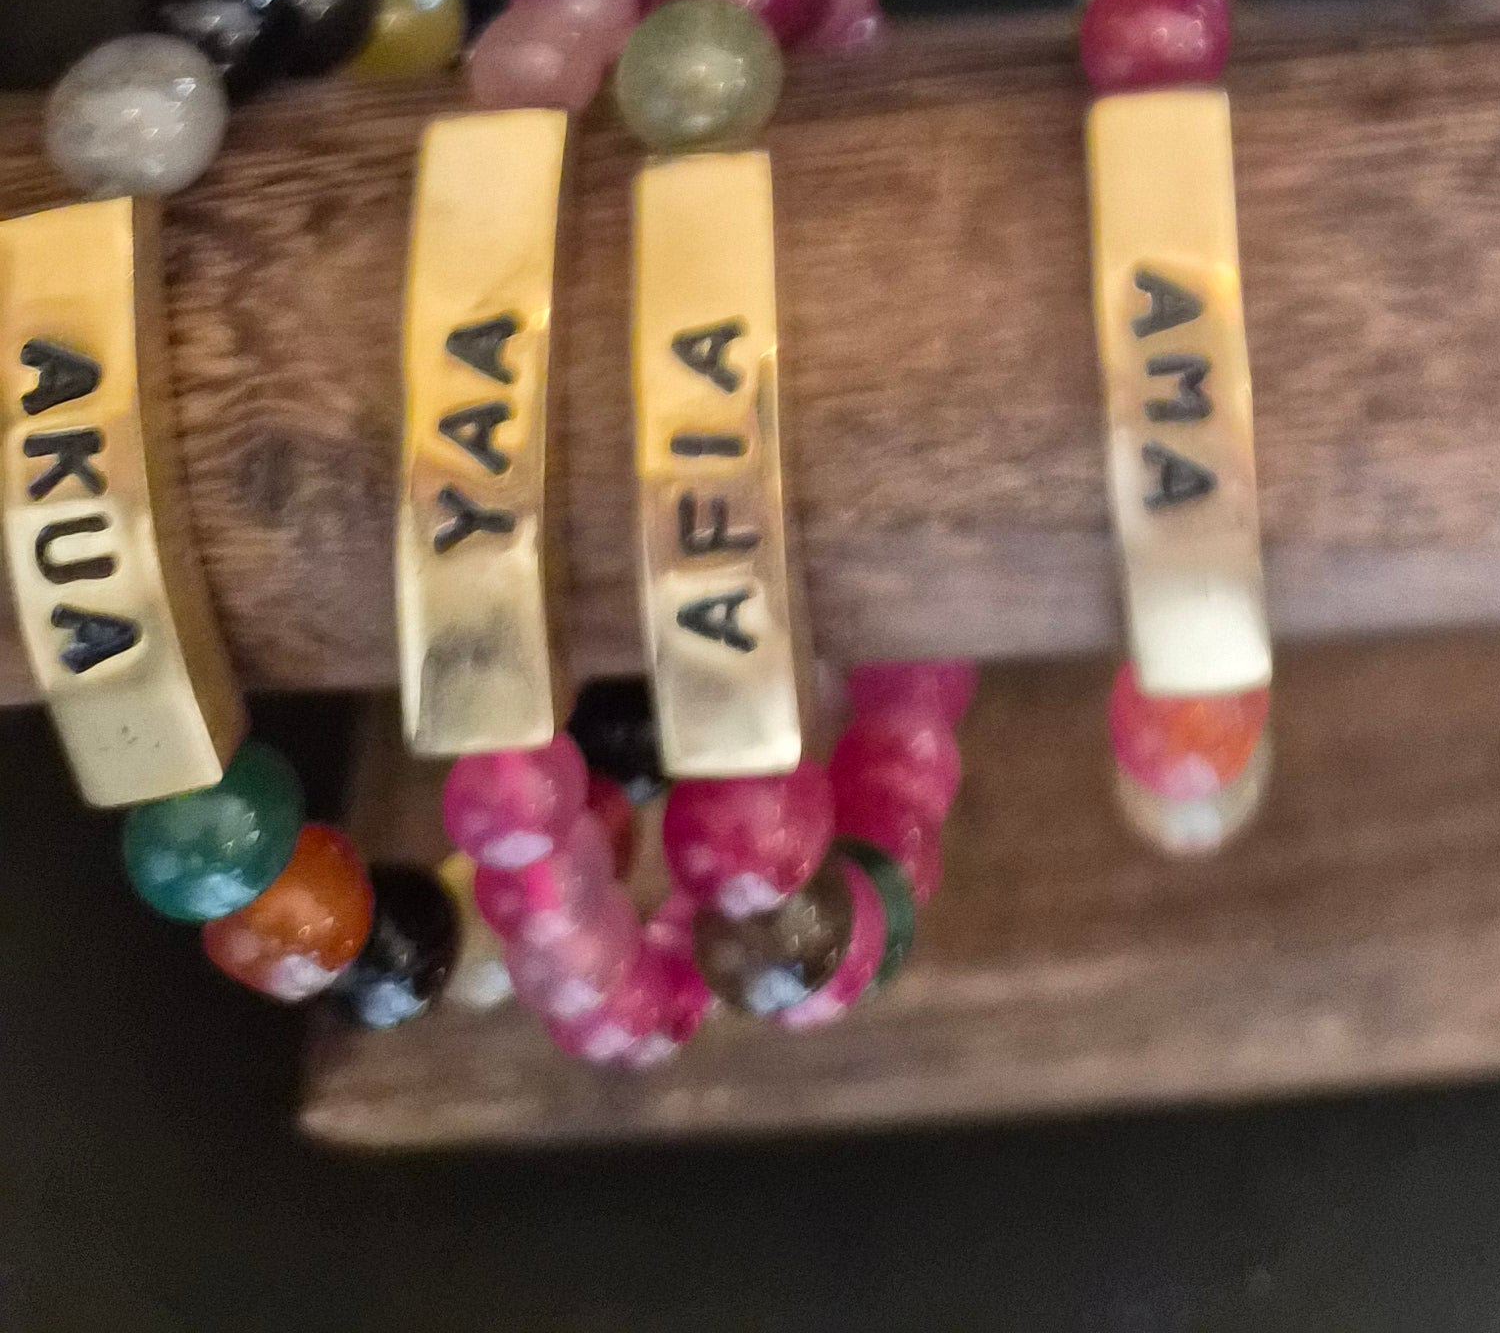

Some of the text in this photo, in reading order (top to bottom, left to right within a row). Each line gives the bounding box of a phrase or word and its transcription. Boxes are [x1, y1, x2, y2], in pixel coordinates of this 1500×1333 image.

[20, 337, 141, 674] AKUA
[434, 311, 519, 553] YAA
[670, 316, 761, 653] AFIA
[1131, 270, 1217, 510] AMA
